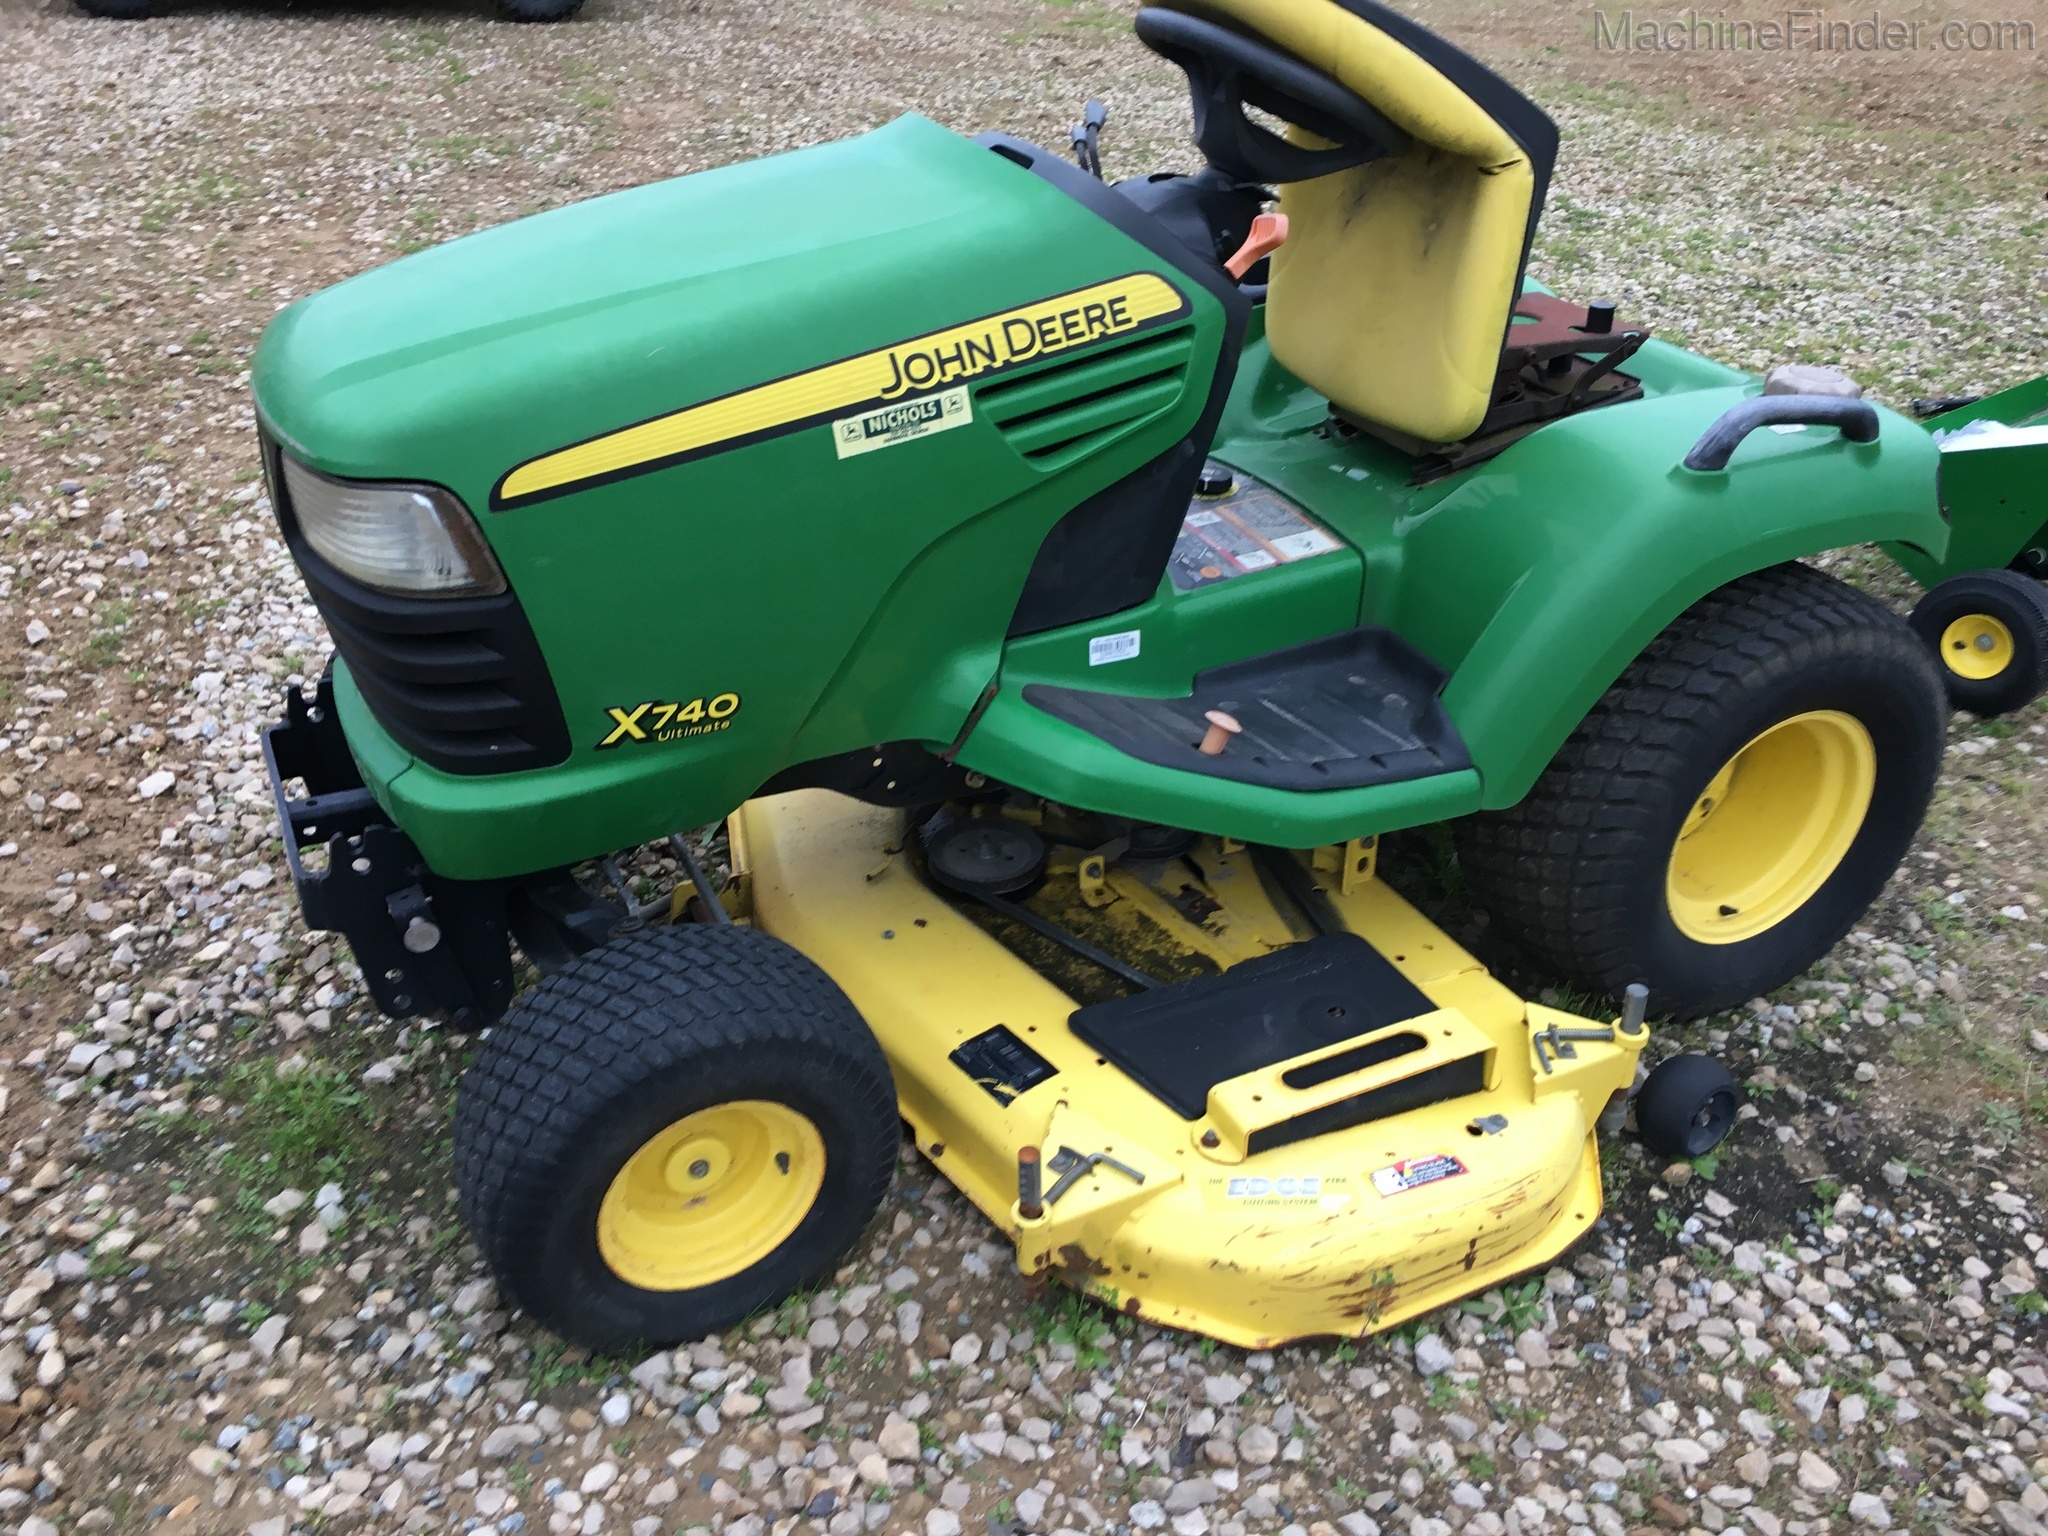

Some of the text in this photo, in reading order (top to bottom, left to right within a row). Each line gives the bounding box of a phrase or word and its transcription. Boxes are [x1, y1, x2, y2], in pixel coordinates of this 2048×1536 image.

[881, 295, 1133, 396] JOHN DEERE
[867, 400, 939, 434] NICHOLS
[599, 691, 740, 746] X740
[657, 719, 731, 742] Ultimate
[1226, 1177, 1320, 1196] EDGE
